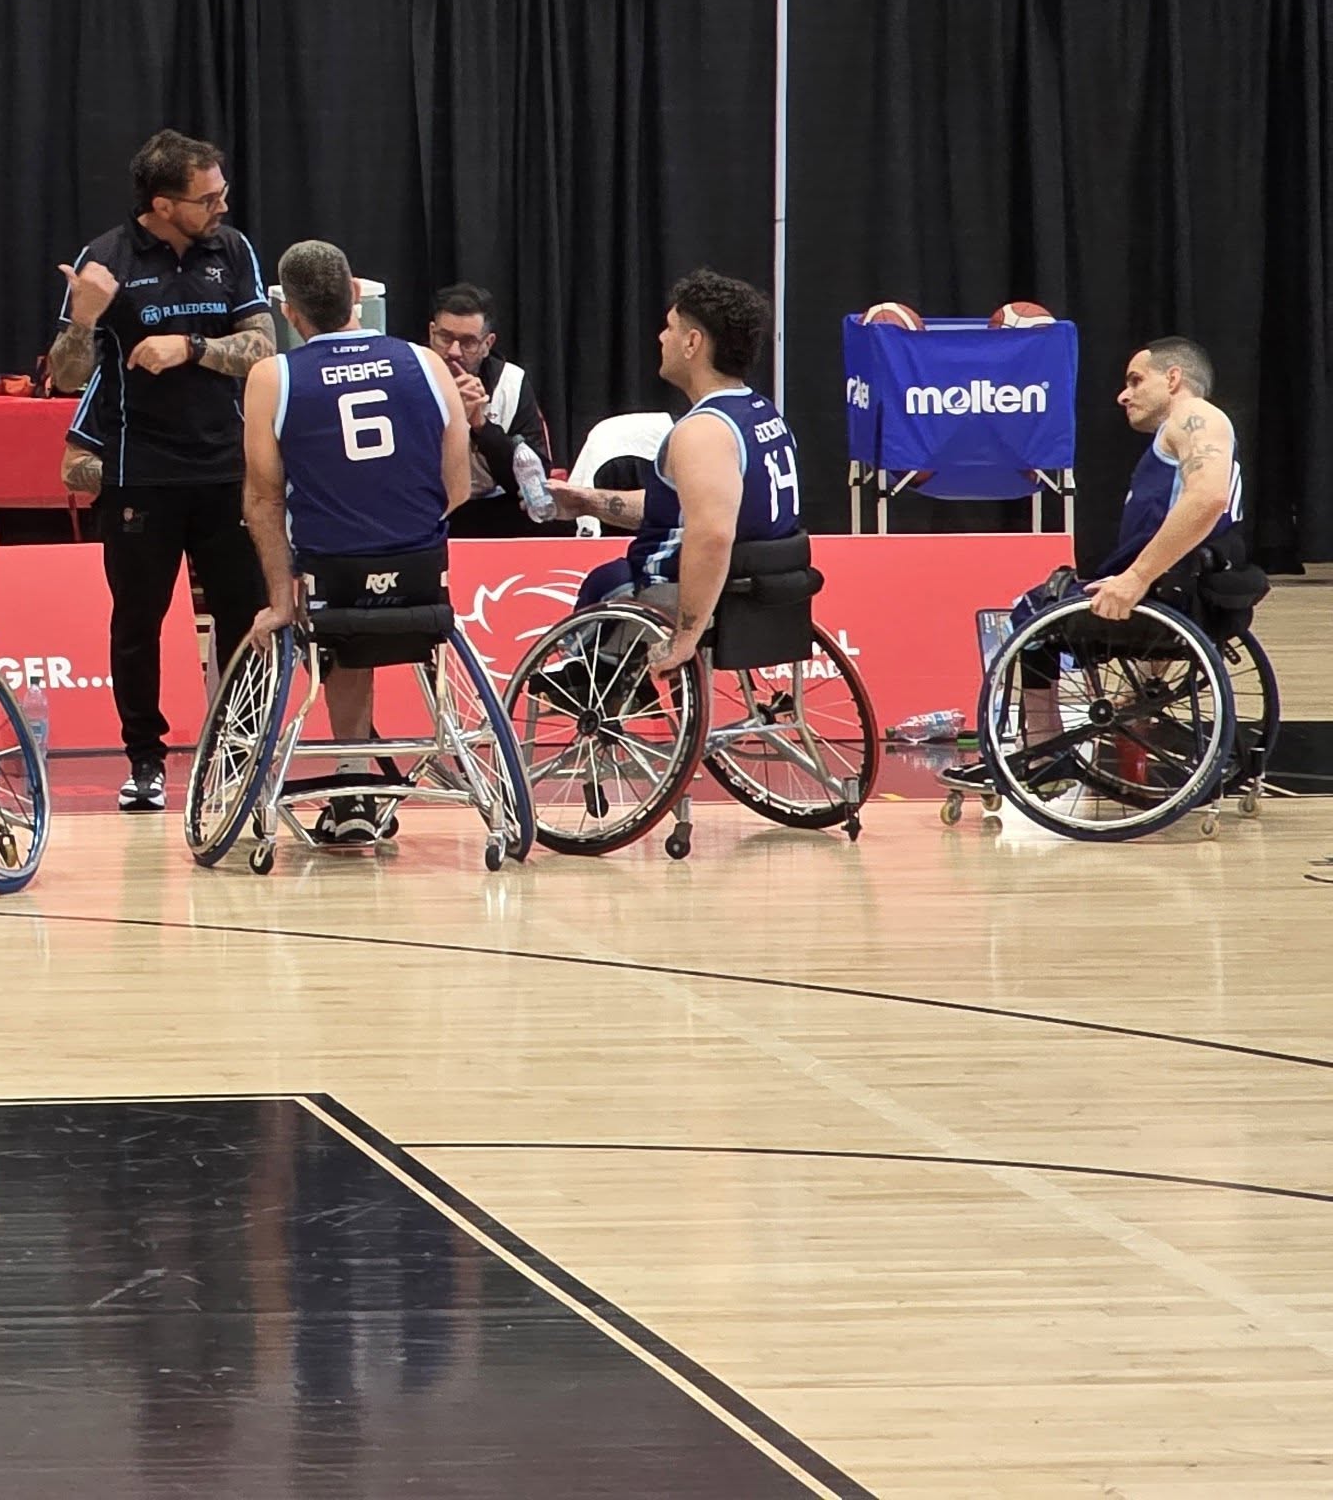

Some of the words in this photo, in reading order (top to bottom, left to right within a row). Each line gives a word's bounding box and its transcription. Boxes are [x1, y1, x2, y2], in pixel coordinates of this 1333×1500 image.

[321, 359, 394, 385] GABAS
[906, 380, 1047, 415] molten
[338, 389, 395, 461] 6
